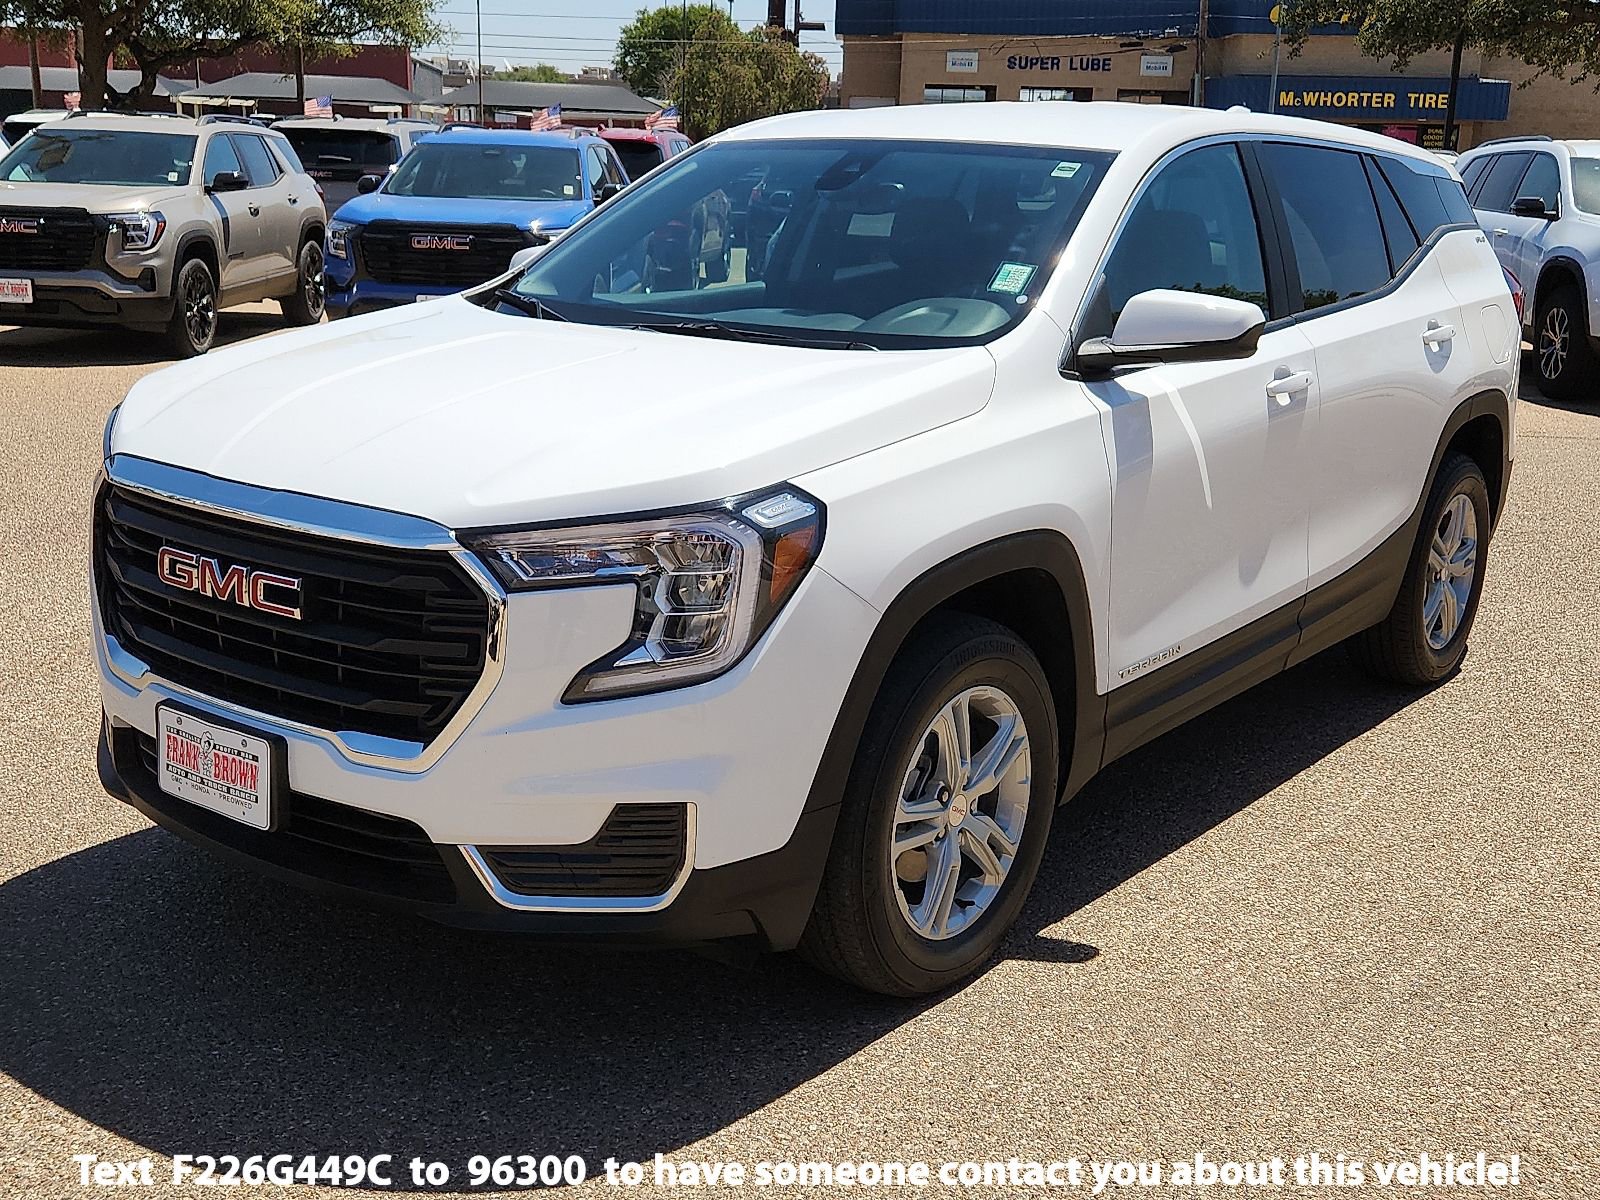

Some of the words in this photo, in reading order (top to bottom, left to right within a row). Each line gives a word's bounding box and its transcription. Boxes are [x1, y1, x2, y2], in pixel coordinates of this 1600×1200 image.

[1007, 55, 1061, 71] SUPER
[1069, 57, 1112, 72] LUBE
[1279, 91, 1395, 109] McWHORTER
[1407, 92, 1450, 109] TIRE
[0, 219, 38, 234] MC
[411, 235, 470, 250] GMC
[158, 546, 302, 620] GMC
[1118, 645, 1181, 678] TERRAIN
[167, 733, 200, 774] FRANK
[213, 751, 259, 793] BROWN
[168, 765, 186, 777] AUTO
[187, 772, 202, 783] AND
[202, 779, 228, 793] TRUCK
[230, 788, 257, 802] RANCH
[171, 774, 183, 785] GMC
[191, 783, 211, 795] HONDA
[219, 792, 253, 809] PREOWNED
